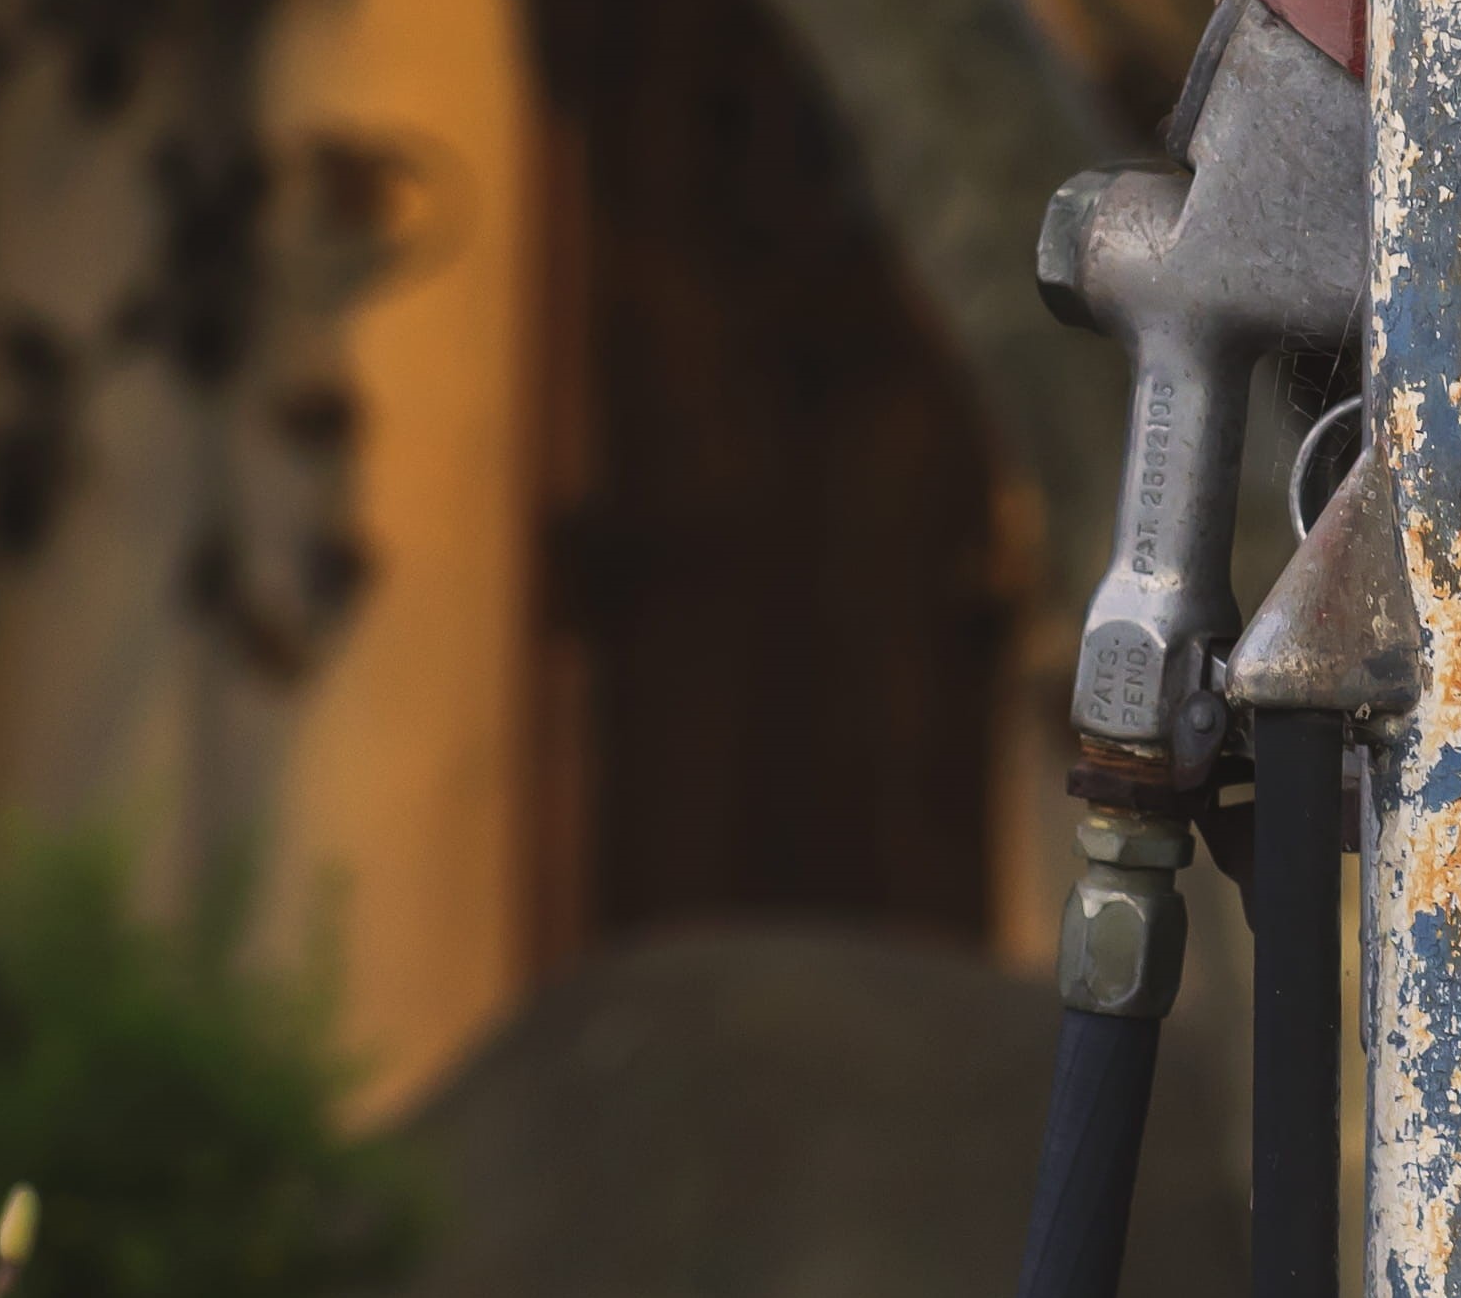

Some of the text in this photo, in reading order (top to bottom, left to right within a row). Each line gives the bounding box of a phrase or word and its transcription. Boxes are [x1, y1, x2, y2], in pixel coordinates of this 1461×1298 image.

[1132, 518, 1159, 575] PAT.
[1090, 639, 1149, 726] PATS. PEND.
